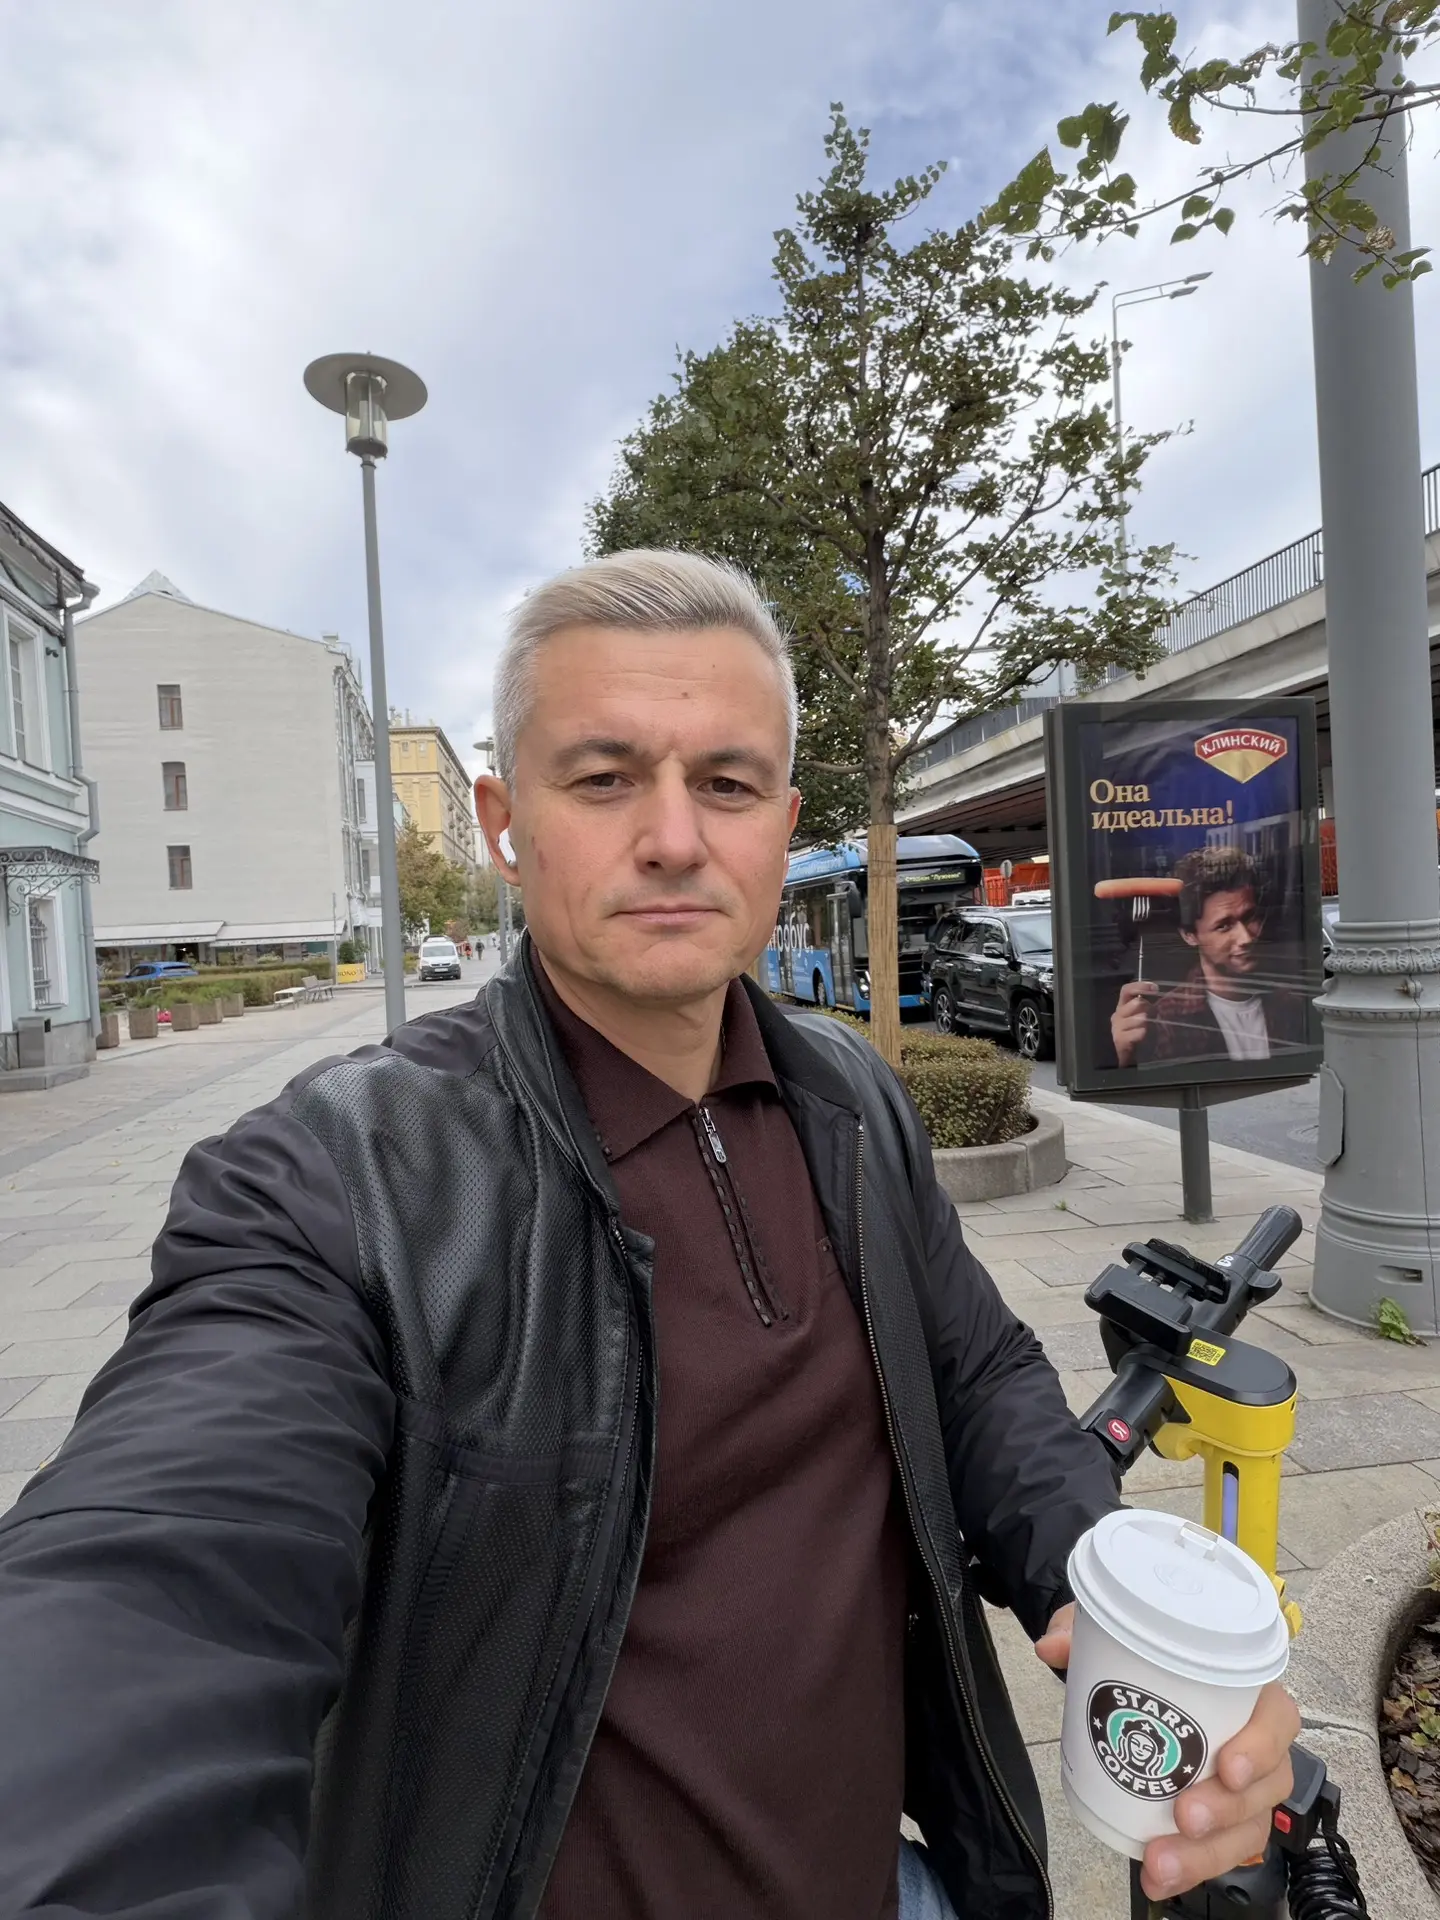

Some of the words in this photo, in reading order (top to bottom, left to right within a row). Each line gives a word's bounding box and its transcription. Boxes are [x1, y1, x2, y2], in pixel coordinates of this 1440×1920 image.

[1201, 734, 1281, 755] КЛИНСКИЙ
[1090, 779, 1151, 804] Она
[1091, 800, 1233, 833] идеальна!
[1113, 1688, 1194, 1738] STARS
[1096, 1740, 1178, 1795] COFFEE
